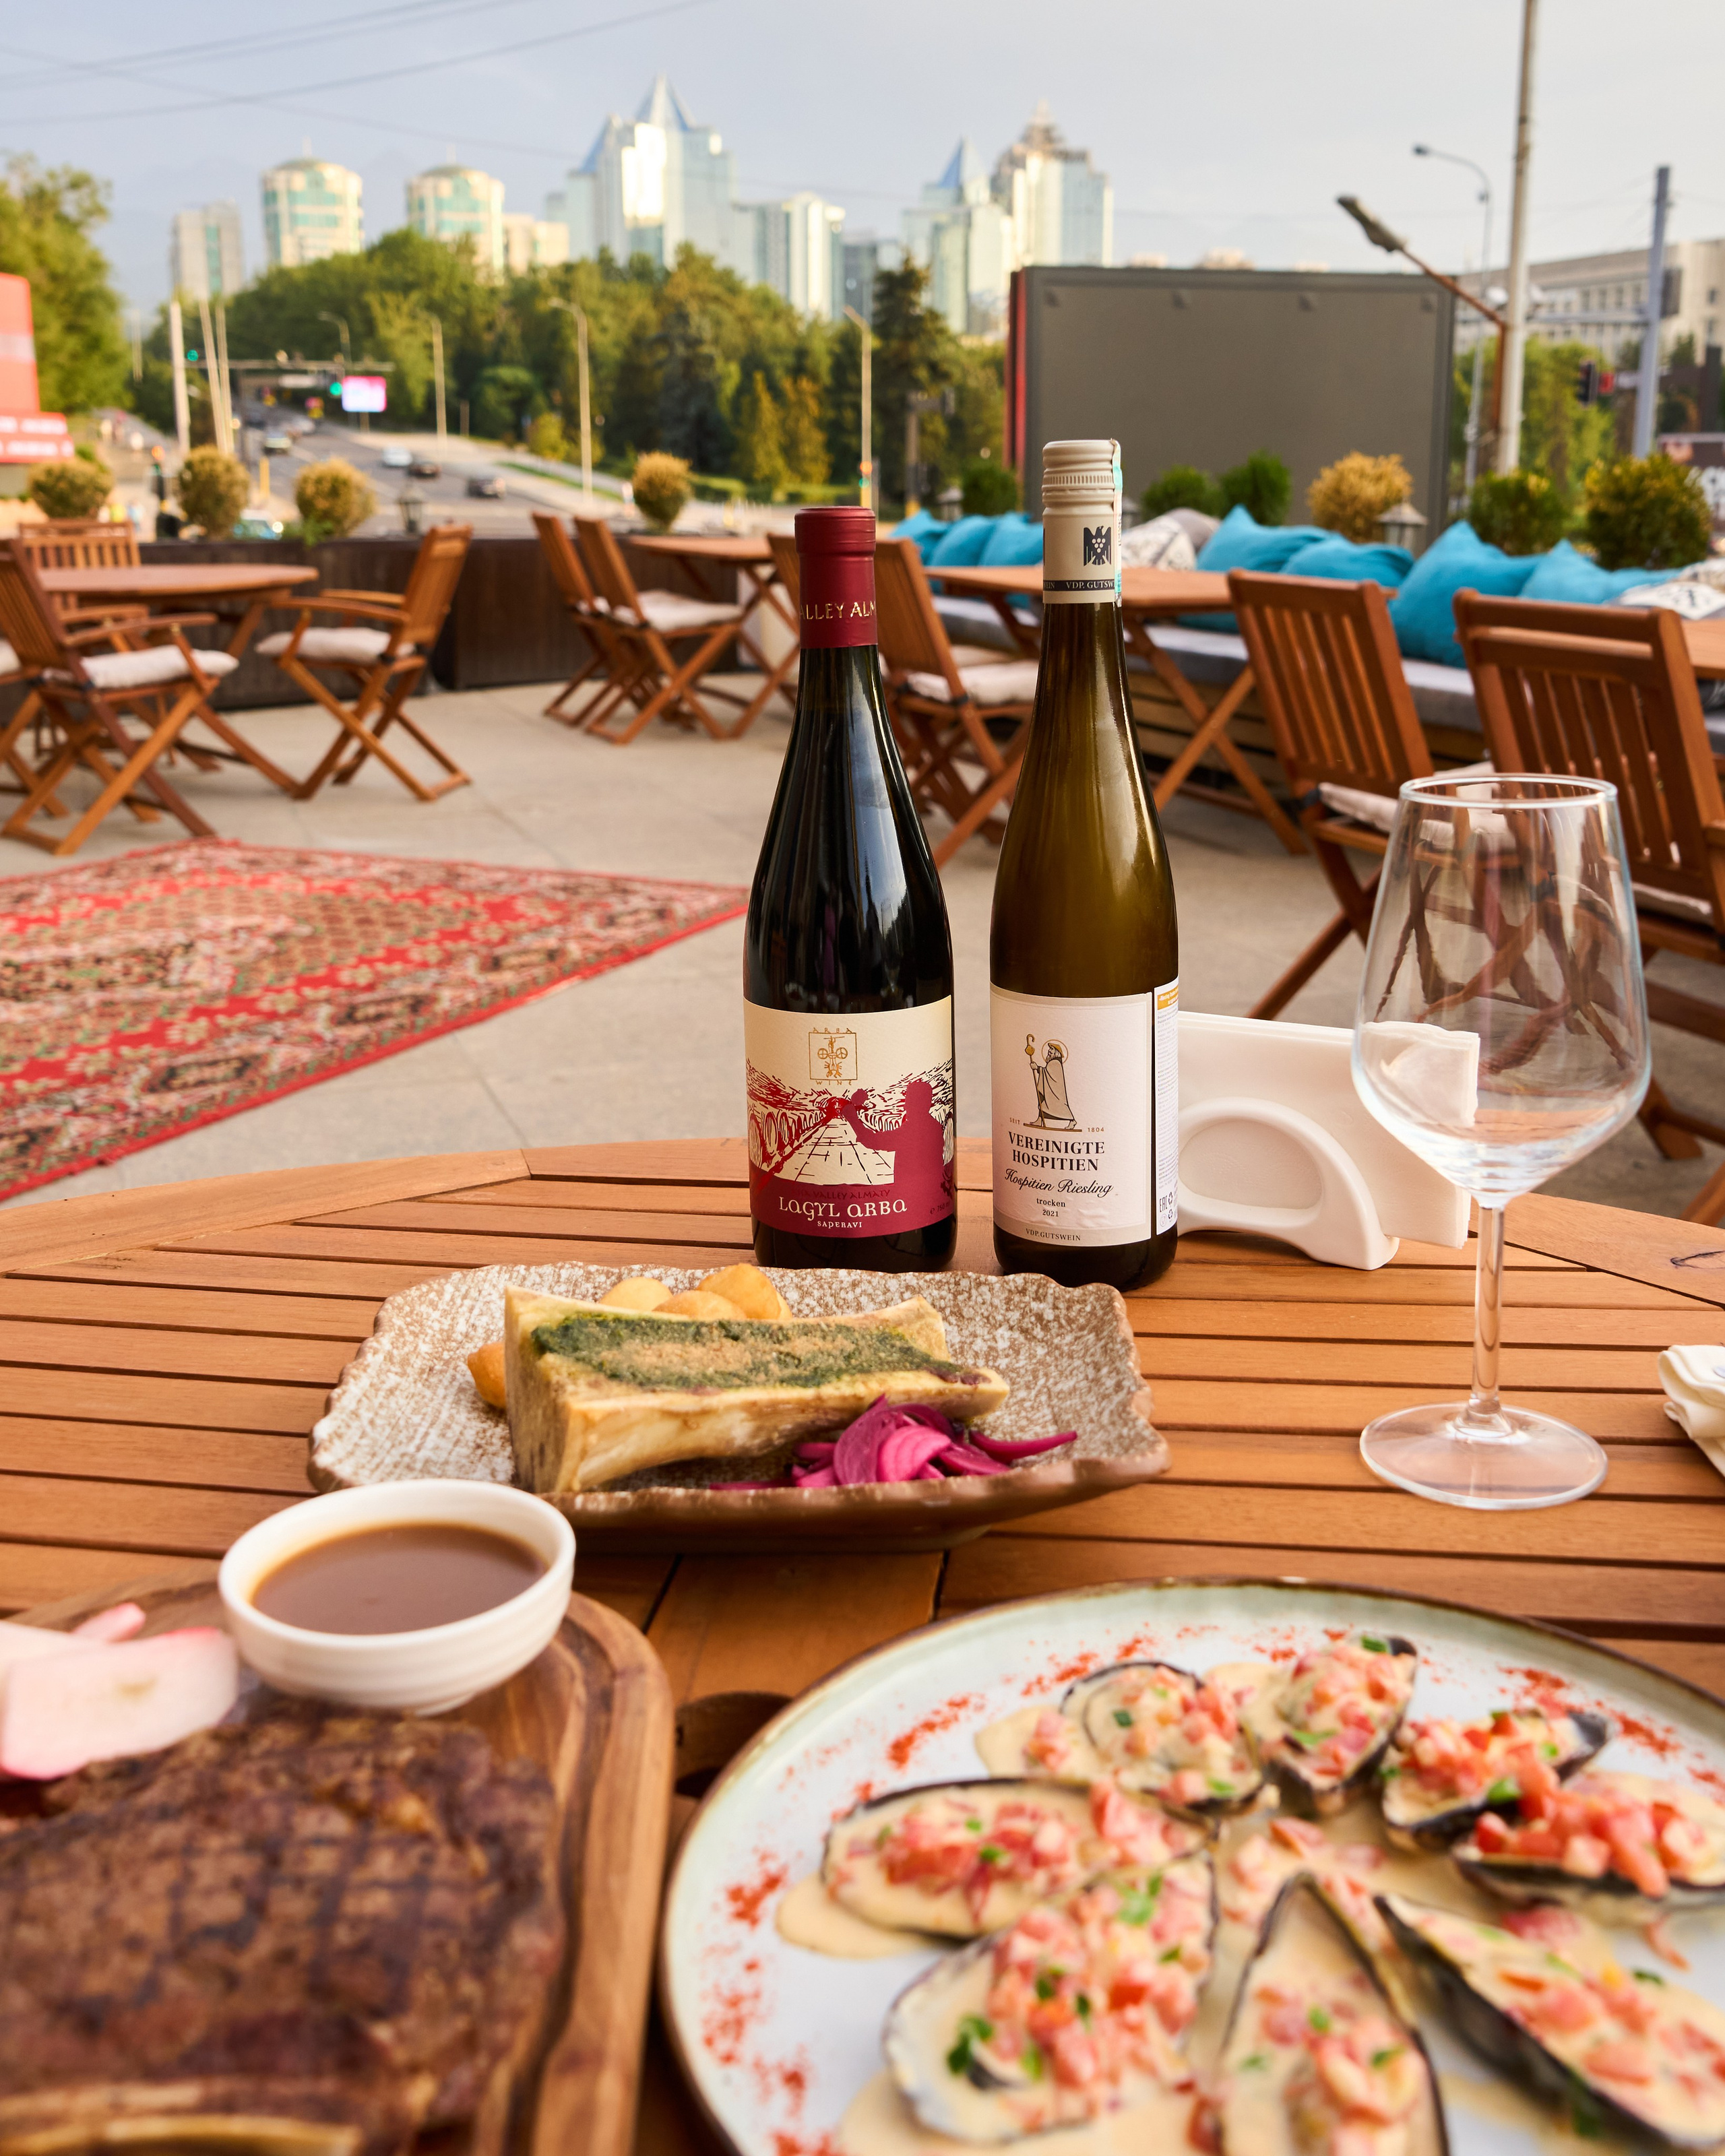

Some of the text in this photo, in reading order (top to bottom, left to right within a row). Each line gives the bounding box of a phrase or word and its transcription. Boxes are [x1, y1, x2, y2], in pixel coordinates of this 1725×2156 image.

[1087, 579, 1115, 589] GUTSW
[1009, 1117, 1020, 1125] SEIT
[1008, 1131, 1105, 1155] VEREINIGTE
[1012, 1149, 1099, 1171] HOSPITIEN
[1004, 1168, 1114, 1198] Hospitien Riesling
[813, 1190, 848, 1200] VALLEY
[850, 1189, 891, 1199] ALMATY
[1036, 1197, 1066, 1207] trocken
[1042, 1209, 1059, 1217] 2021
[817, 1220, 862, 1229] SAPERAVI
[1026, 1228, 1081, 1241] VDP.GUTSWEIN
